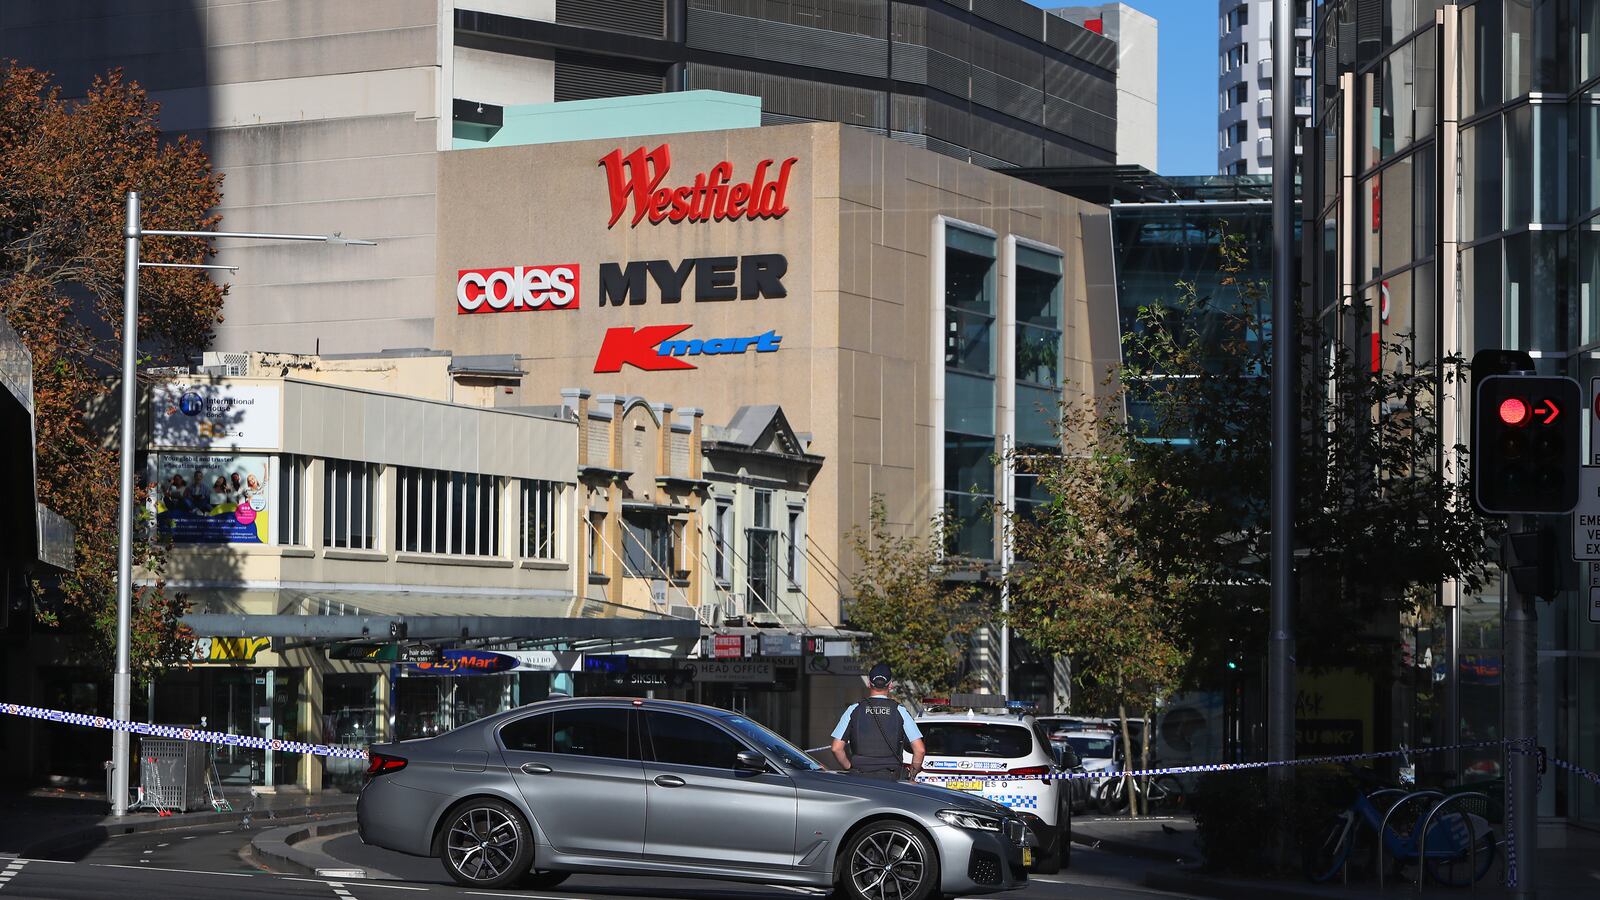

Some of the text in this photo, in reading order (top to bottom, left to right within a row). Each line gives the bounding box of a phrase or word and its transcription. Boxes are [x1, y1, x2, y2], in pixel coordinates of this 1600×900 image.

[598, 143, 800, 229] Westfield
[457, 265, 576, 311] coles
[599, 253, 788, 307] MYER
[593, 324, 783, 373] Kmart
[206, 397, 255, 406] International
[630, 673, 668, 685] SIKSILK
[701, 663, 769, 675] HEAD OFFICE
[865, 707, 891, 716] POLICE
